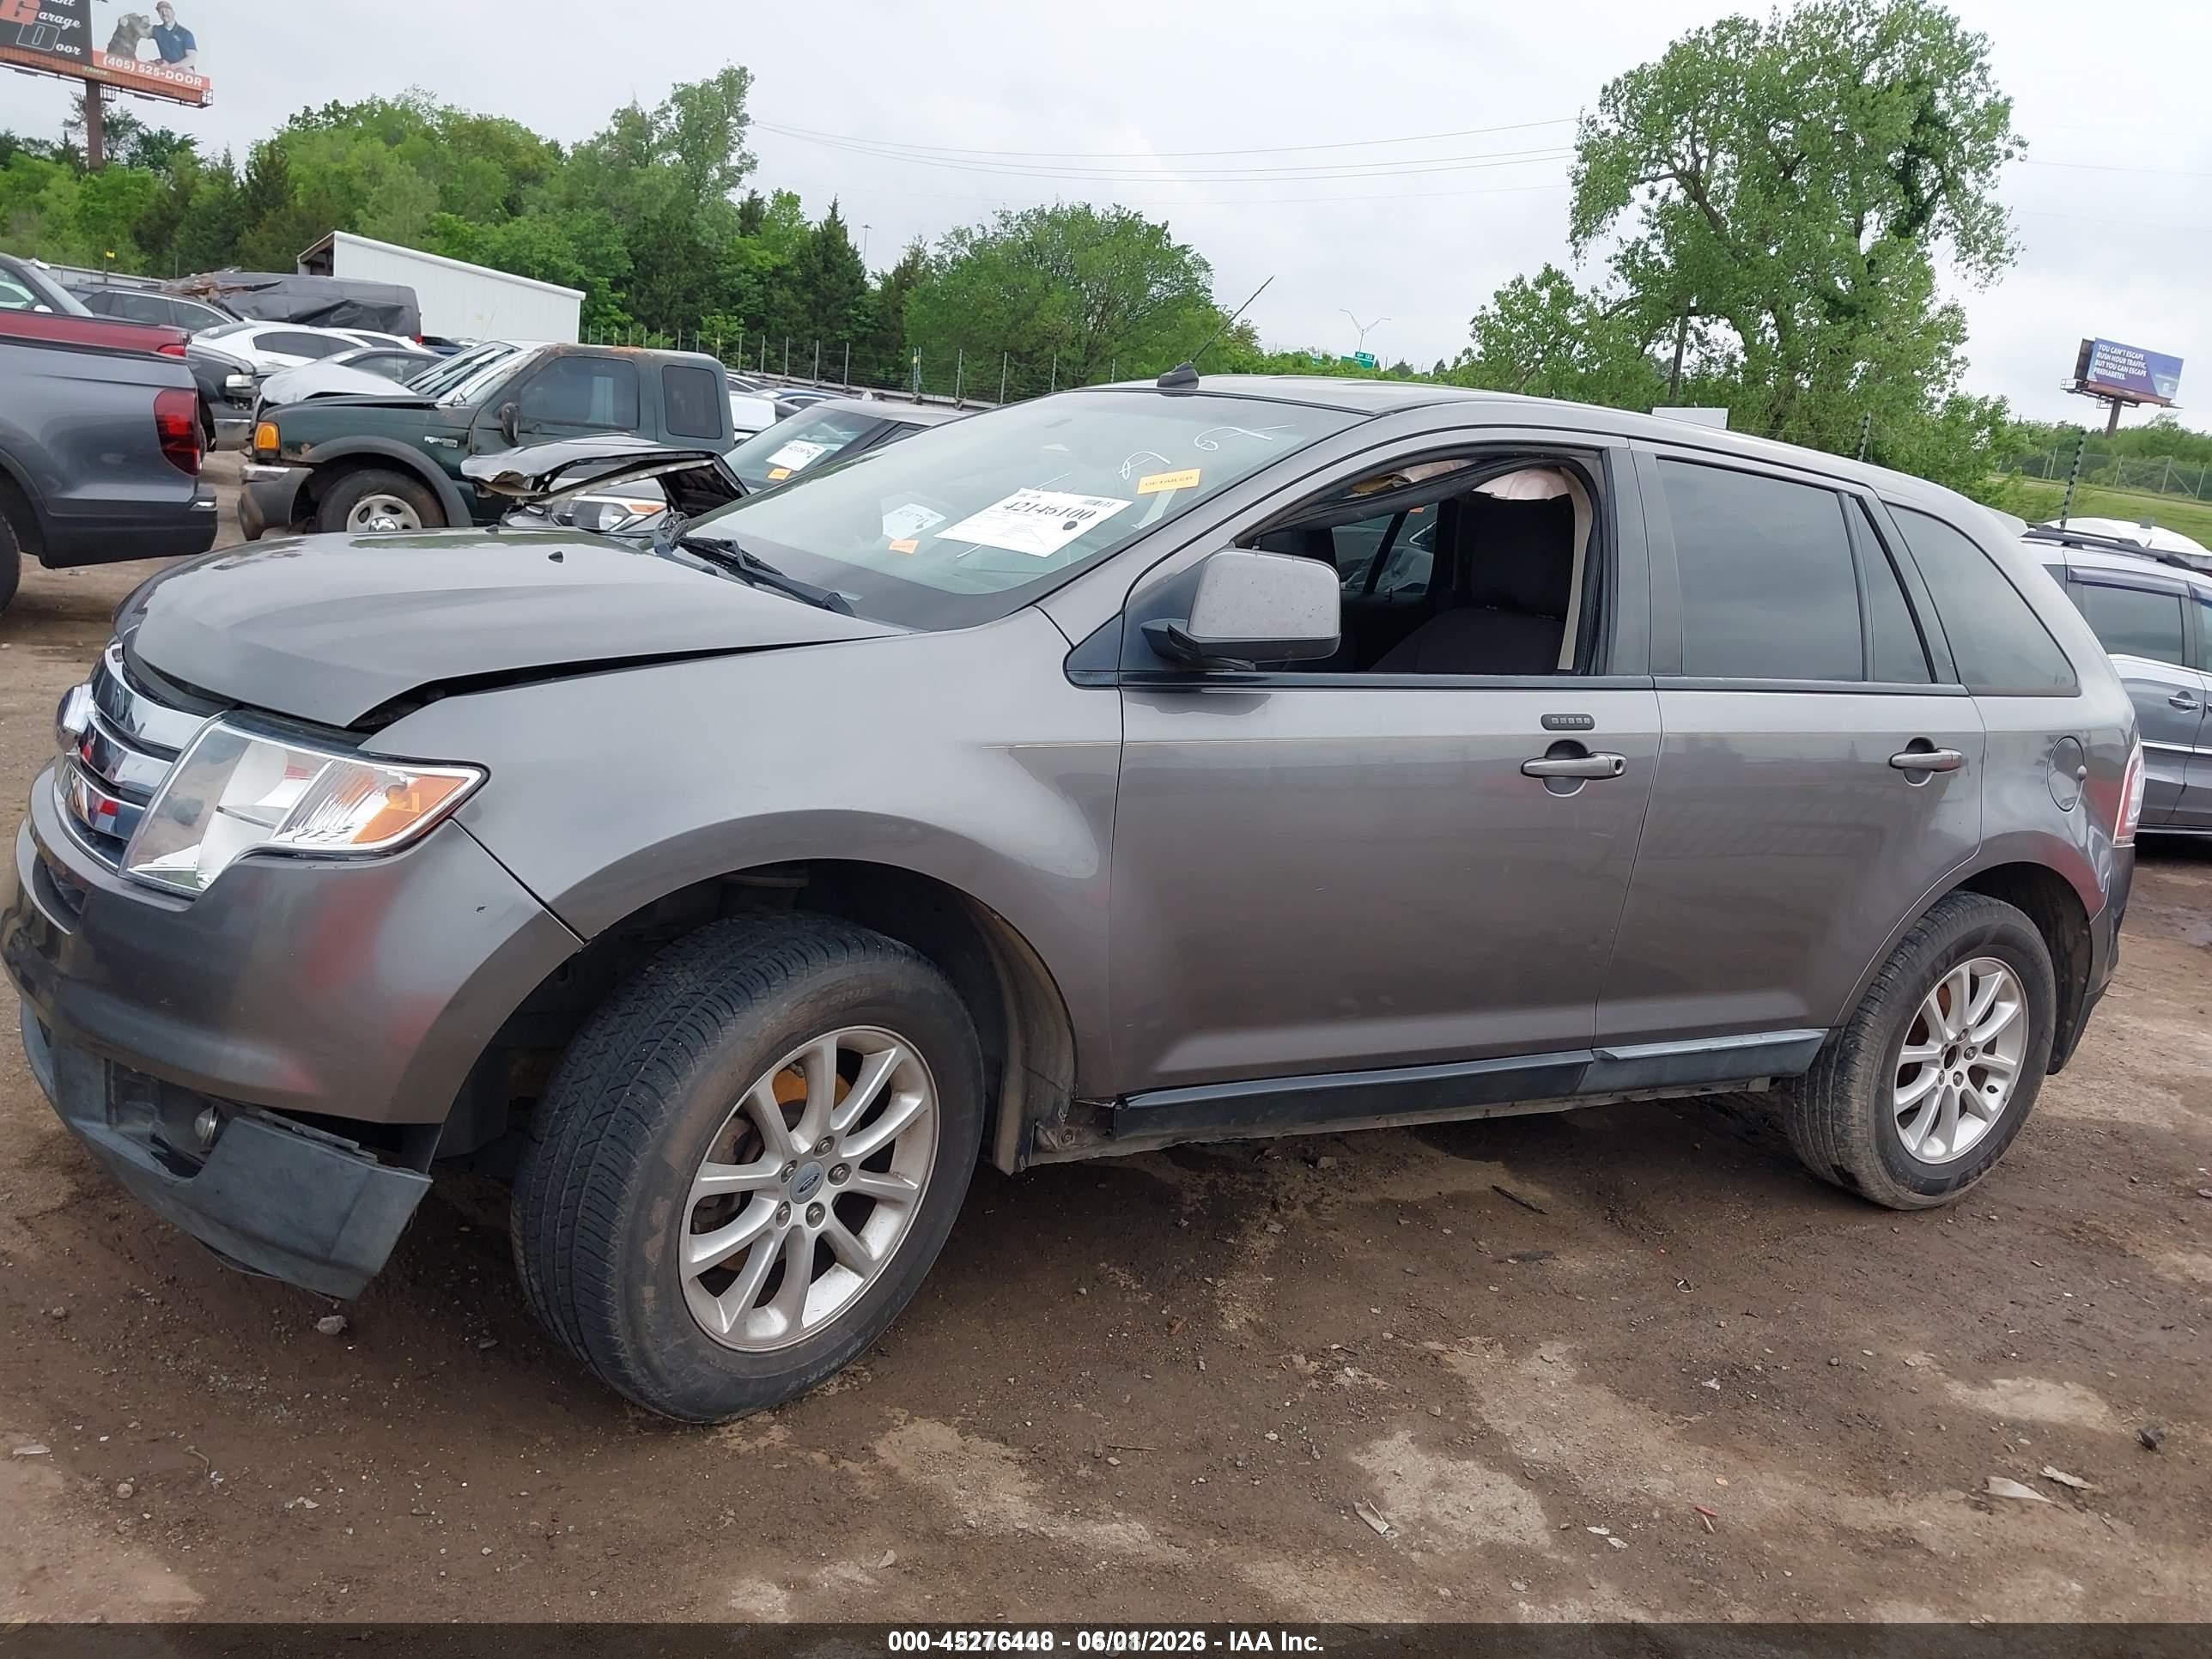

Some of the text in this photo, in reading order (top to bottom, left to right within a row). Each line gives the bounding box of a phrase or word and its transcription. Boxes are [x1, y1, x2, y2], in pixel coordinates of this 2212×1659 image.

[103, 55, 136, 72] (405)
[138, 64, 203, 87] 525-DOOR
[2097, 351, 2112, 361] RUSH
[2112, 356, 2127, 364] HOUR
[2099, 343, 2145, 361] YOU CAN'T ESCAPE
[2095, 359, 2147, 377] BUT YOU CAN ESCAPE
